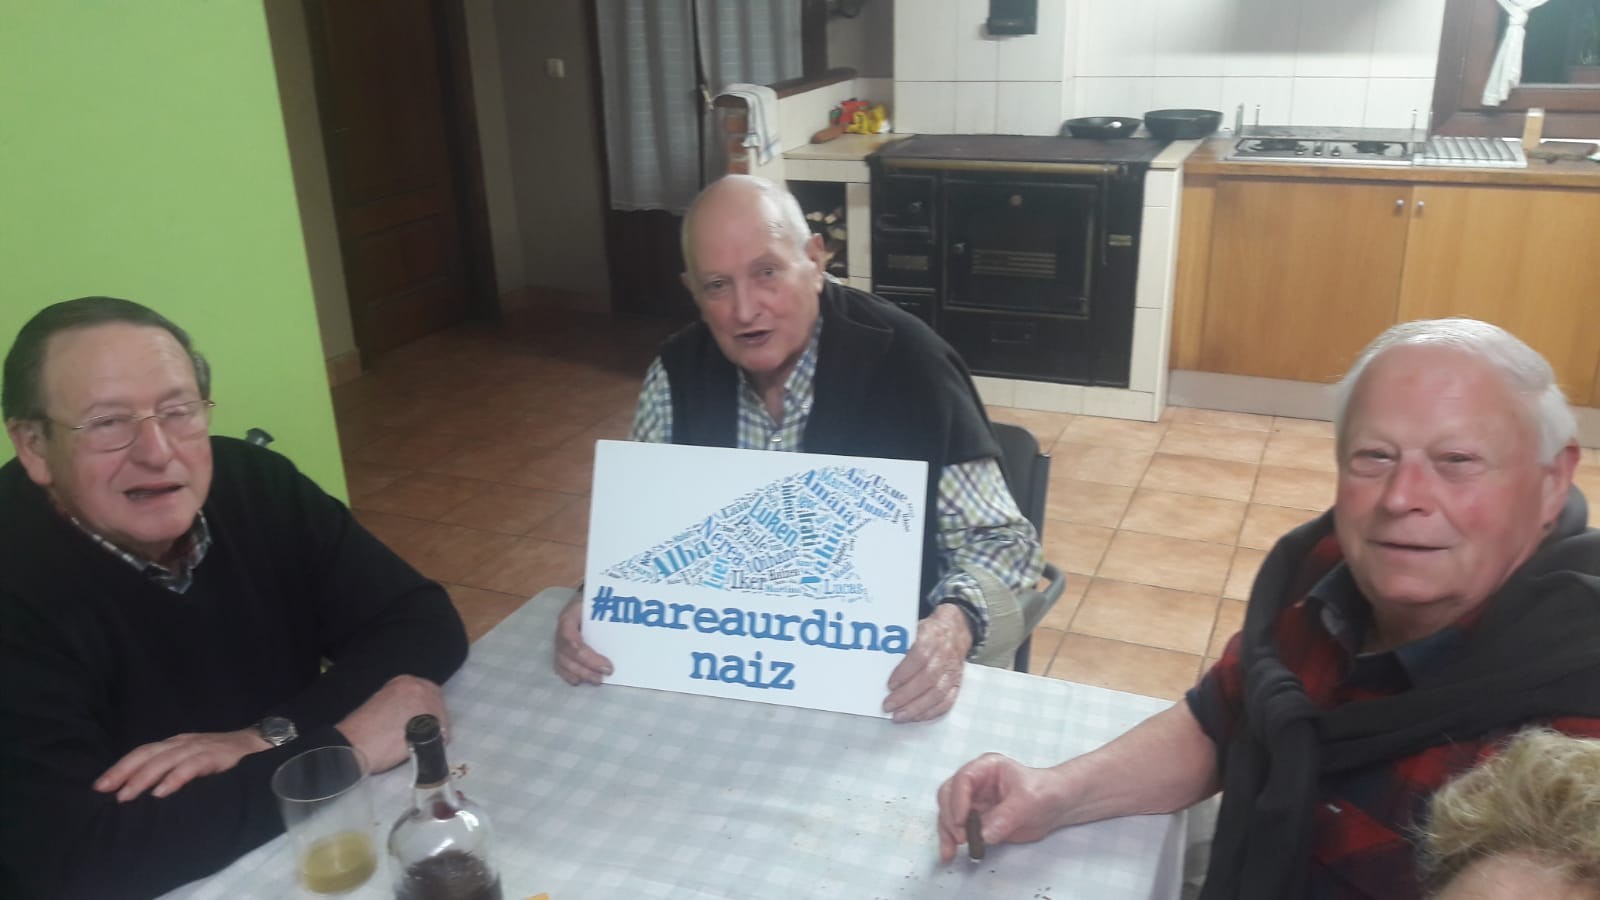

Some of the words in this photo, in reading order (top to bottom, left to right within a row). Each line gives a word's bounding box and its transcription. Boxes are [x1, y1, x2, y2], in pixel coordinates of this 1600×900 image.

[803, 469, 855, 526] Amaia
[873, 475, 908, 500] Uxue
[701, 515, 745, 566] Nerea
[749, 496, 799, 547] Luken
[653, 541, 713, 578] Alba
[731, 569, 763, 590] Iker
[590, 585, 909, 655] #mareaurdina
[689, 651, 795, 690] naiz
